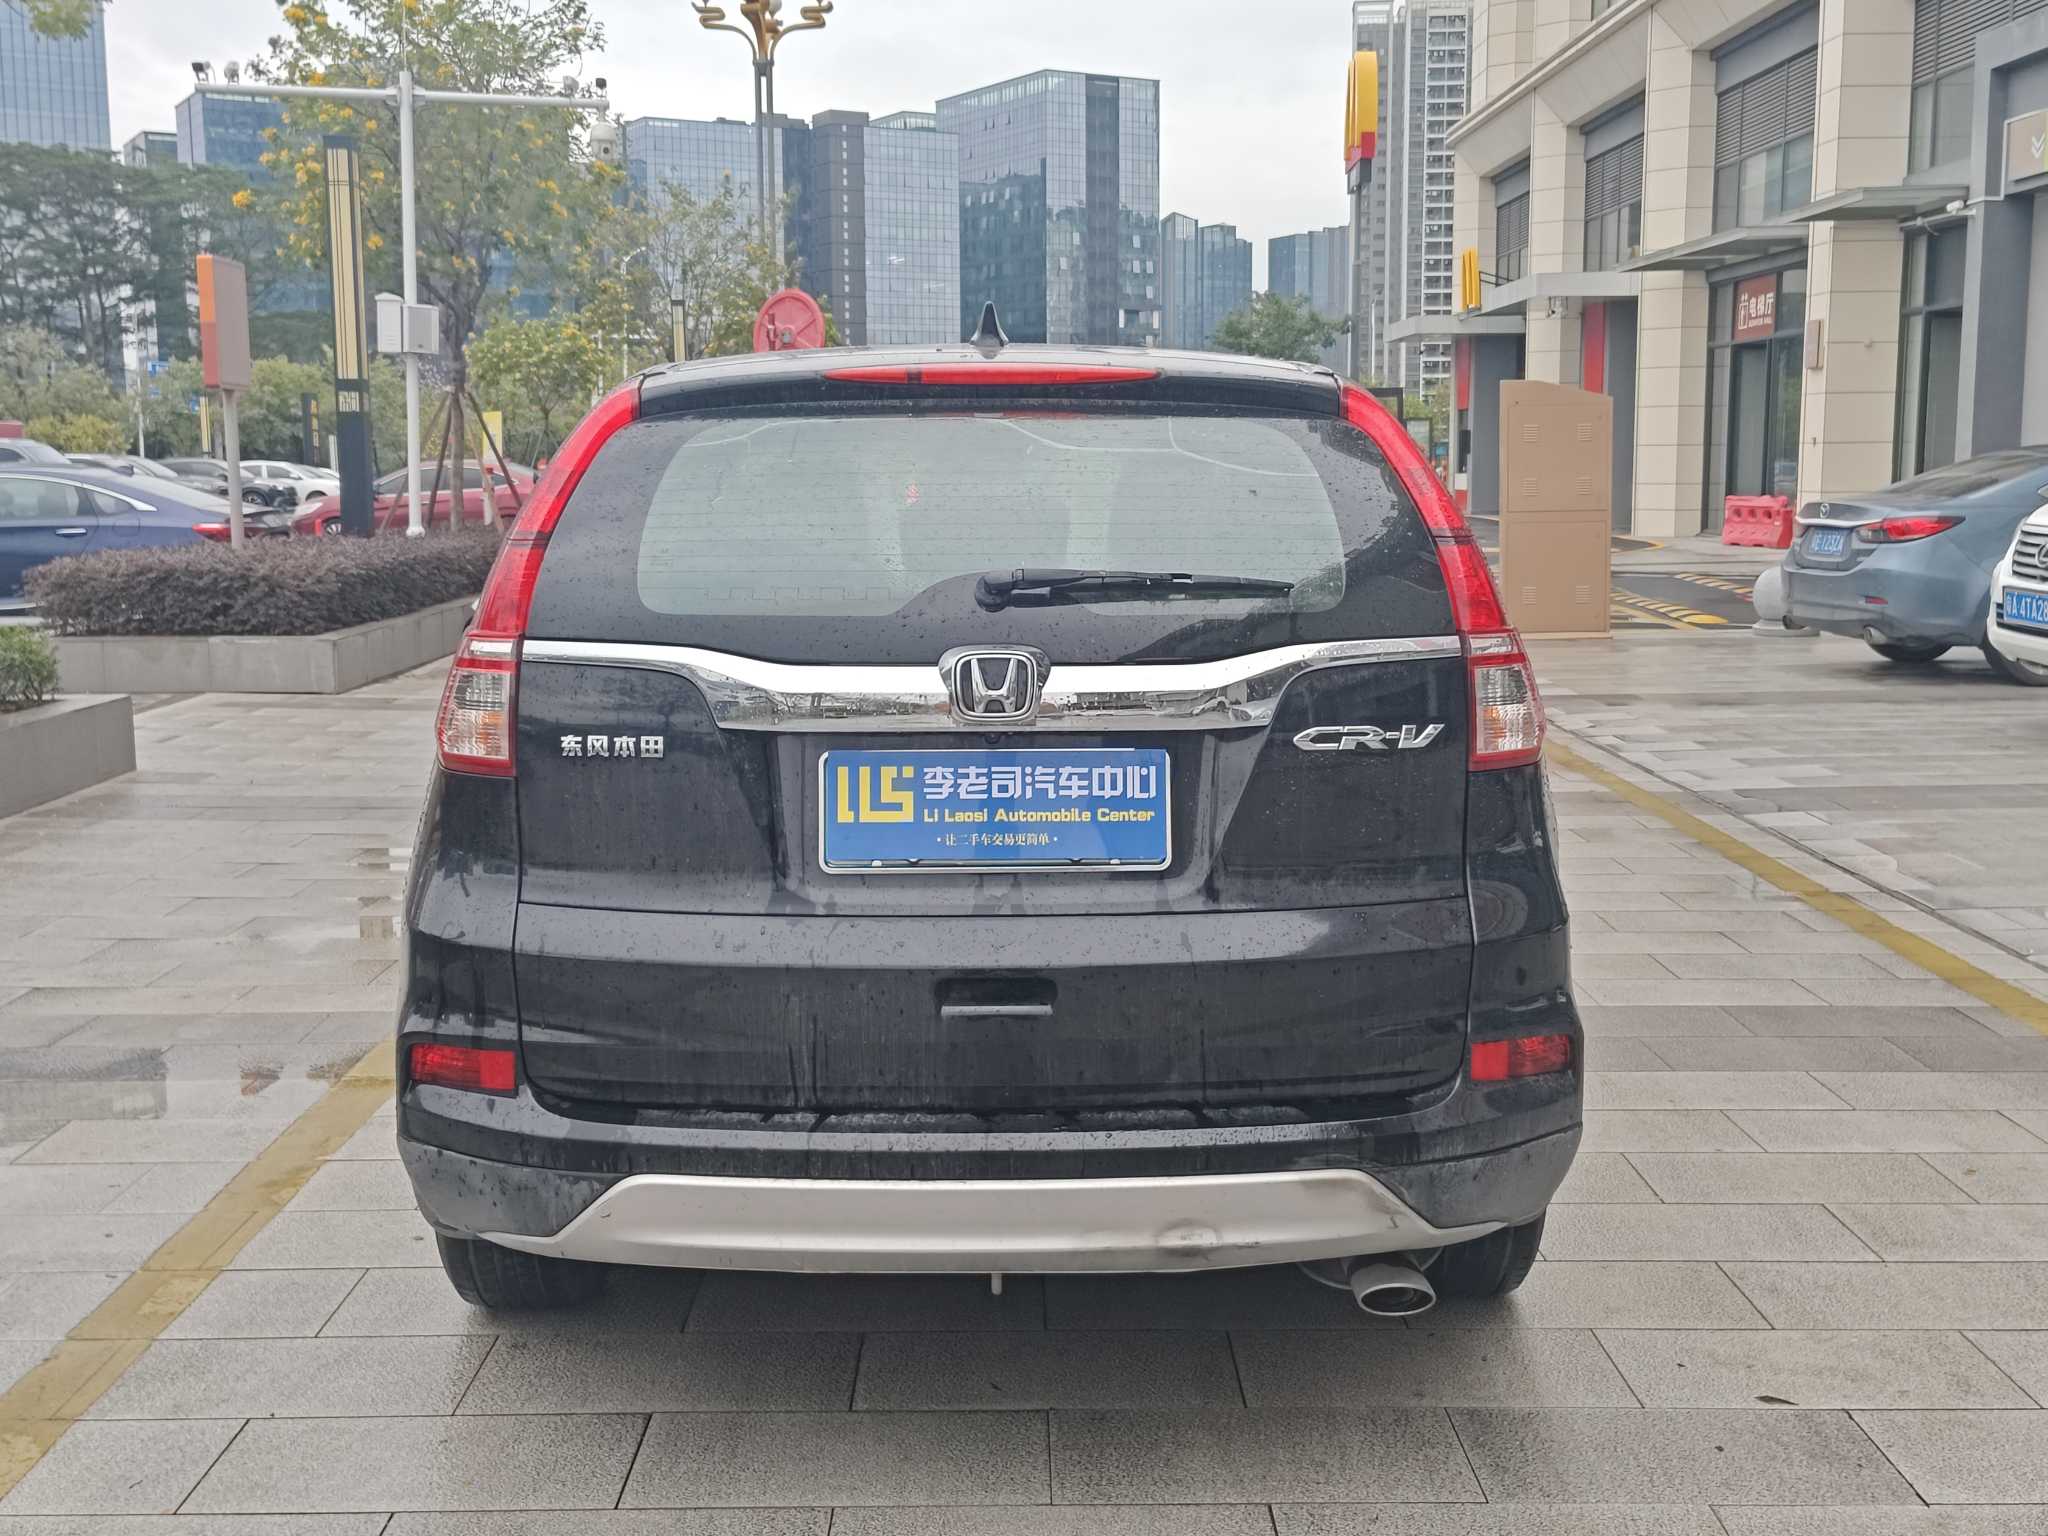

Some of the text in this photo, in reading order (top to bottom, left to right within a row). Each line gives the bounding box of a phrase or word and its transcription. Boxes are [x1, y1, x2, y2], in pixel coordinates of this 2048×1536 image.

[560, 734, 664, 758] 东风本田
[1293, 723, 1445, 751] CR-V
[923, 765, 1157, 799] 李老司汽车中心
[923, 808, 1155, 823] Li Laosi Automobile Center
